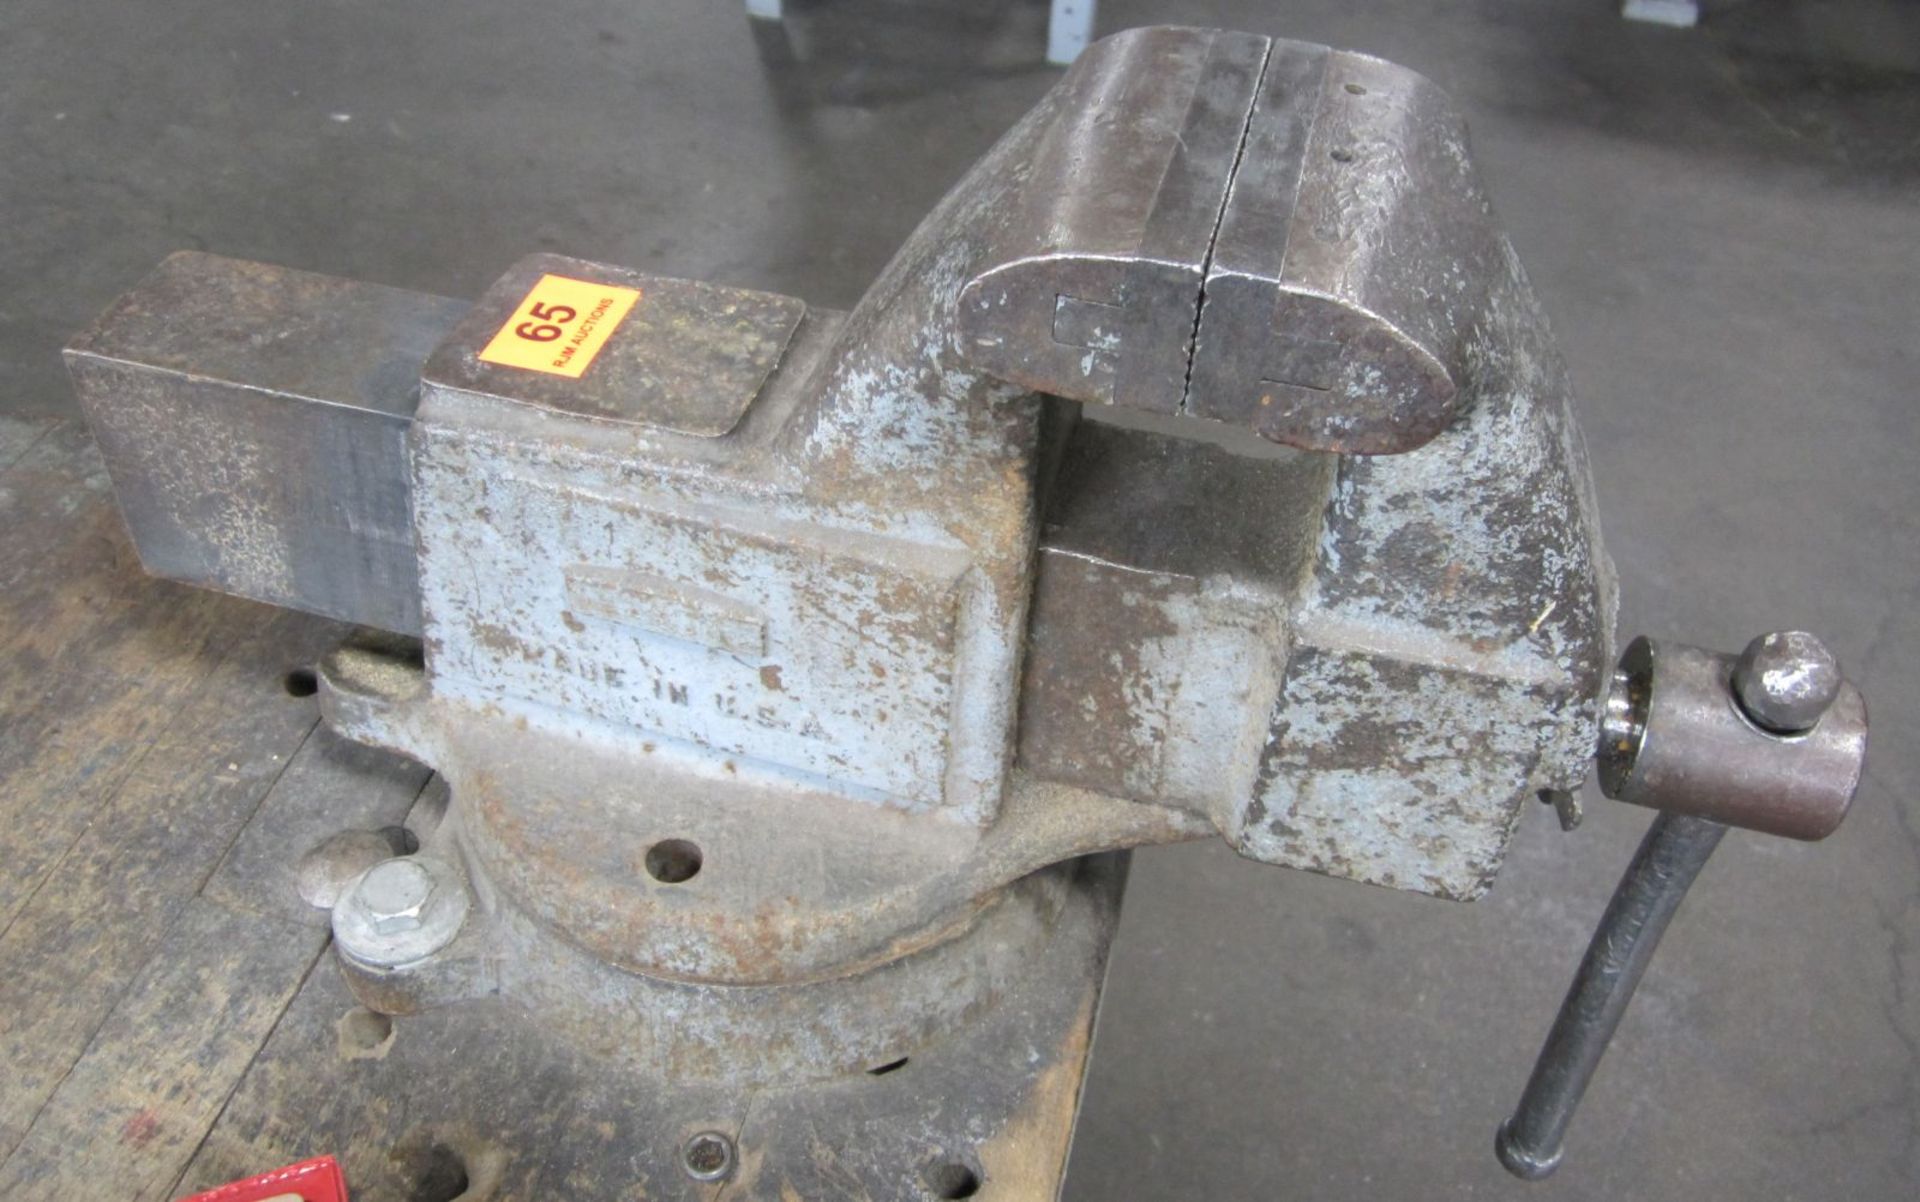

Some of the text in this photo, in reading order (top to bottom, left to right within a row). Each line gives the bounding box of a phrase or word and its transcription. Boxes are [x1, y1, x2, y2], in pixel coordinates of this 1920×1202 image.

[515, 302, 577, 342] 65
[552, 298, 614, 368] RJM AUCTIONS
